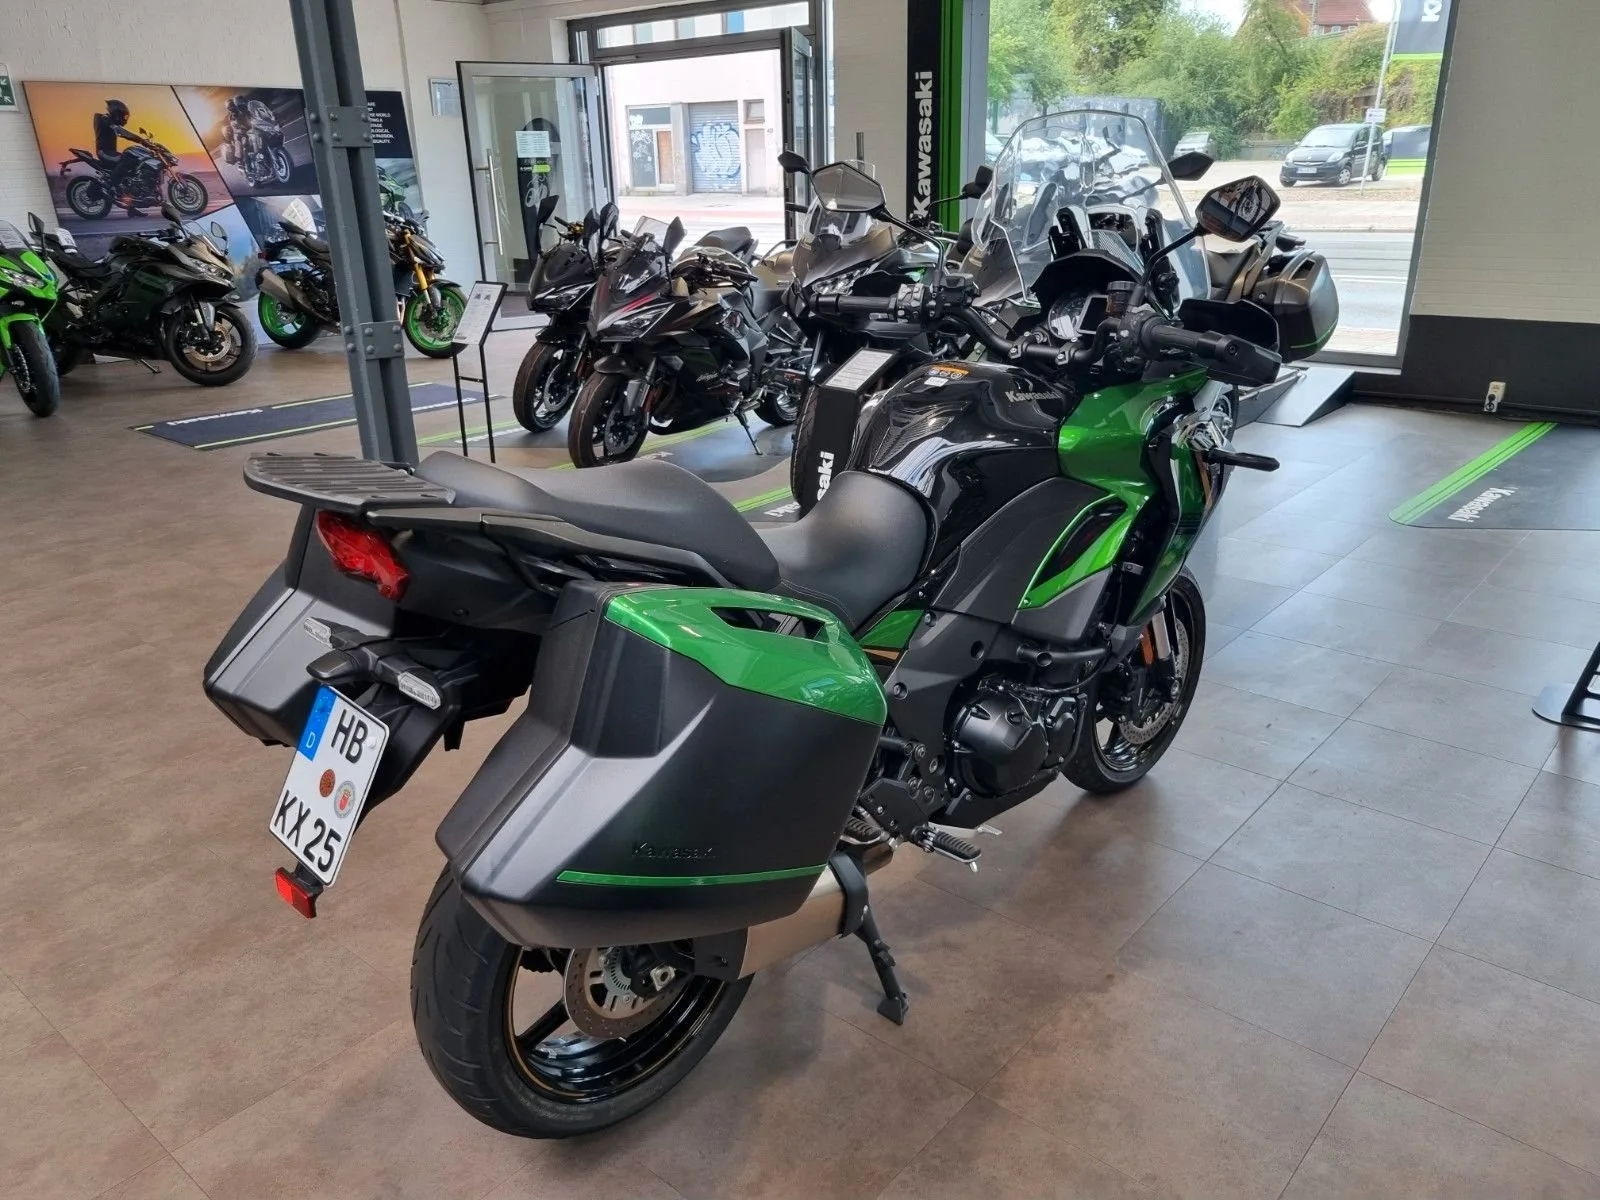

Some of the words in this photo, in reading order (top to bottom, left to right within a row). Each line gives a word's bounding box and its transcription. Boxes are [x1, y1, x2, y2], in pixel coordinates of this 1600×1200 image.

[912, 71, 933, 219] Kawasaki
[305, 731, 316, 749] D
[330, 708, 369, 764] HB
[273, 789, 312, 848] KX
[302, 817, 342, 873] 25
